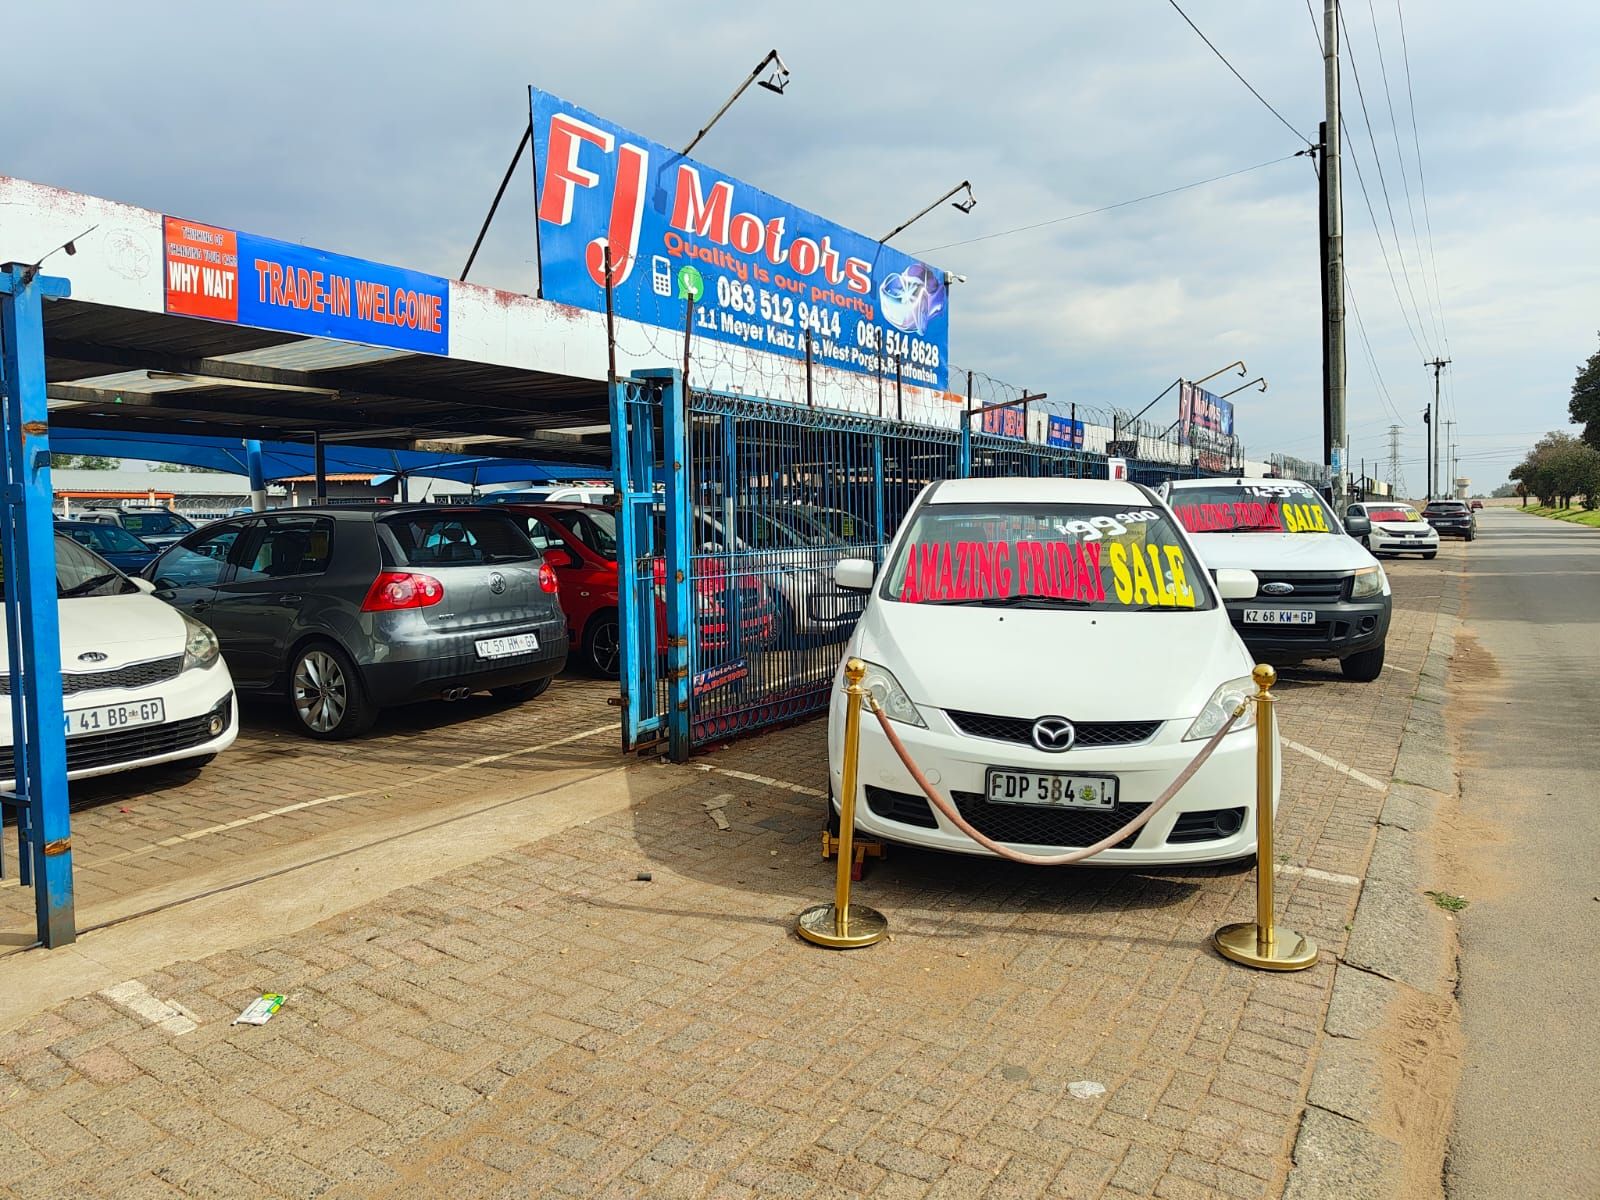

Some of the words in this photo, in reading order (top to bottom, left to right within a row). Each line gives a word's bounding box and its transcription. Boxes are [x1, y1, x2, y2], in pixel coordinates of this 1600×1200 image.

[538, 112, 650, 289] FJ
[669, 164, 873, 295] Motors
[169, 261, 200, 295] WHY
[202, 266, 235, 300] WAIT
[664, 231, 748, 281] Quality
[774, 274, 807, 295] our
[811, 286, 874, 321] priority
[254, 258, 351, 318] TRADE-IN
[355, 279, 442, 334] WELCOME
[717, 275, 755, 315] 083
[760, 288, 794, 327] 512
[798, 301, 841, 339] 9414
[720, 312, 764, 342] Meyer
[766, 324, 795, 349] Katz
[886, 329, 909, 359] 514
[911, 338, 939, 367] 8628
[121, 498, 164, 507] OFFIE
[1282, 503, 1329, 533] SALE
[901, 541, 1013, 603] AMAZING
[1016, 541, 1105, 602] FRIDAY
[1109, 542, 1196, 608] SALE
[1246, 611, 1258, 622] KZ
[1262, 612, 1275, 622] 68
[1280, 612, 1292, 622] KW
[1301, 612, 1313, 623] GP
[479, 640, 492, 654] KZ
[495, 639, 505, 652] 59
[80, 711, 100, 730] 41
[108, 707, 128, 726] BB
[140, 702, 159, 720] GP
[991, 773, 1030, 799] FDP
[1037, 777, 1076, 802] 584
[1100, 781, 1112, 805] L
